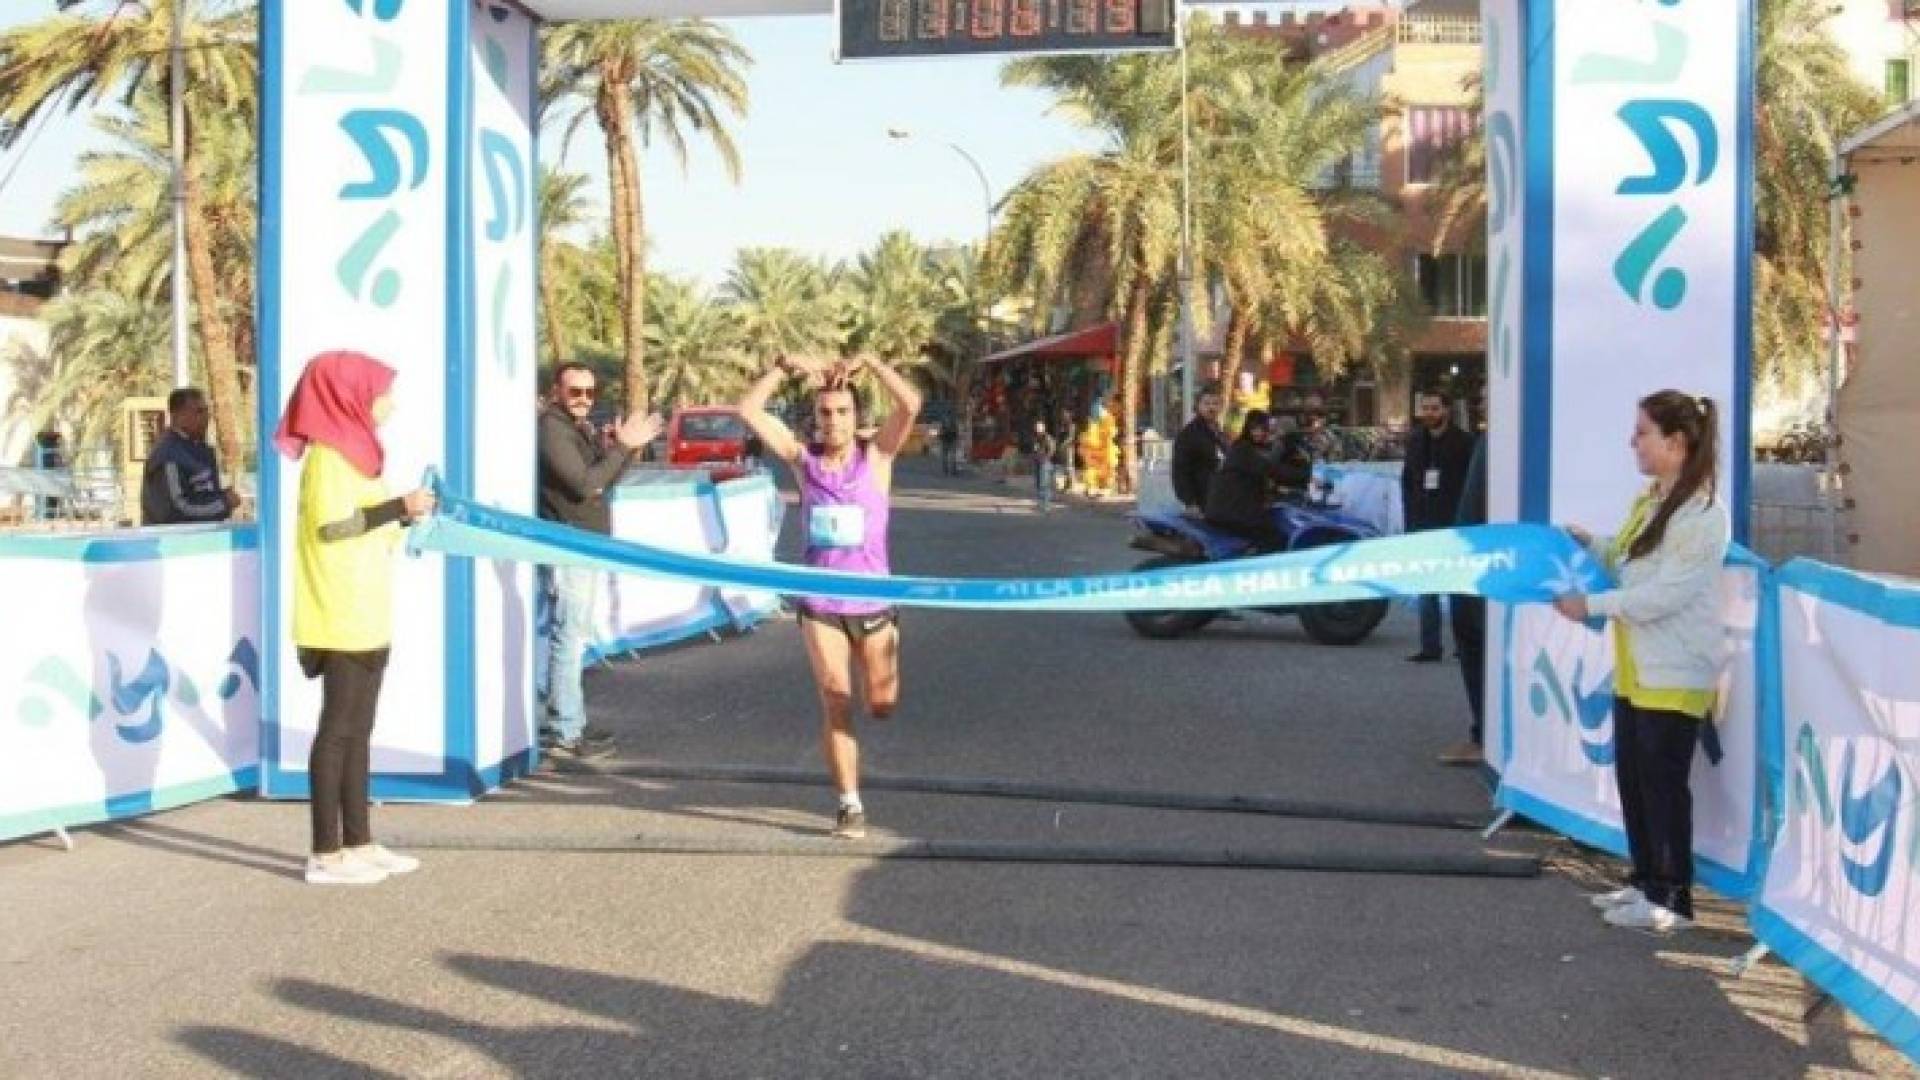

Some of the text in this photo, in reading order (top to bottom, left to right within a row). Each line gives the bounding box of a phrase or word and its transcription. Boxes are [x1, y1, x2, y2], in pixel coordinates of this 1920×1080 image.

[297, 0, 430, 309] ayl
[1570, 0, 1718, 311] ayl
[1160, 574, 1224, 597] SEA
